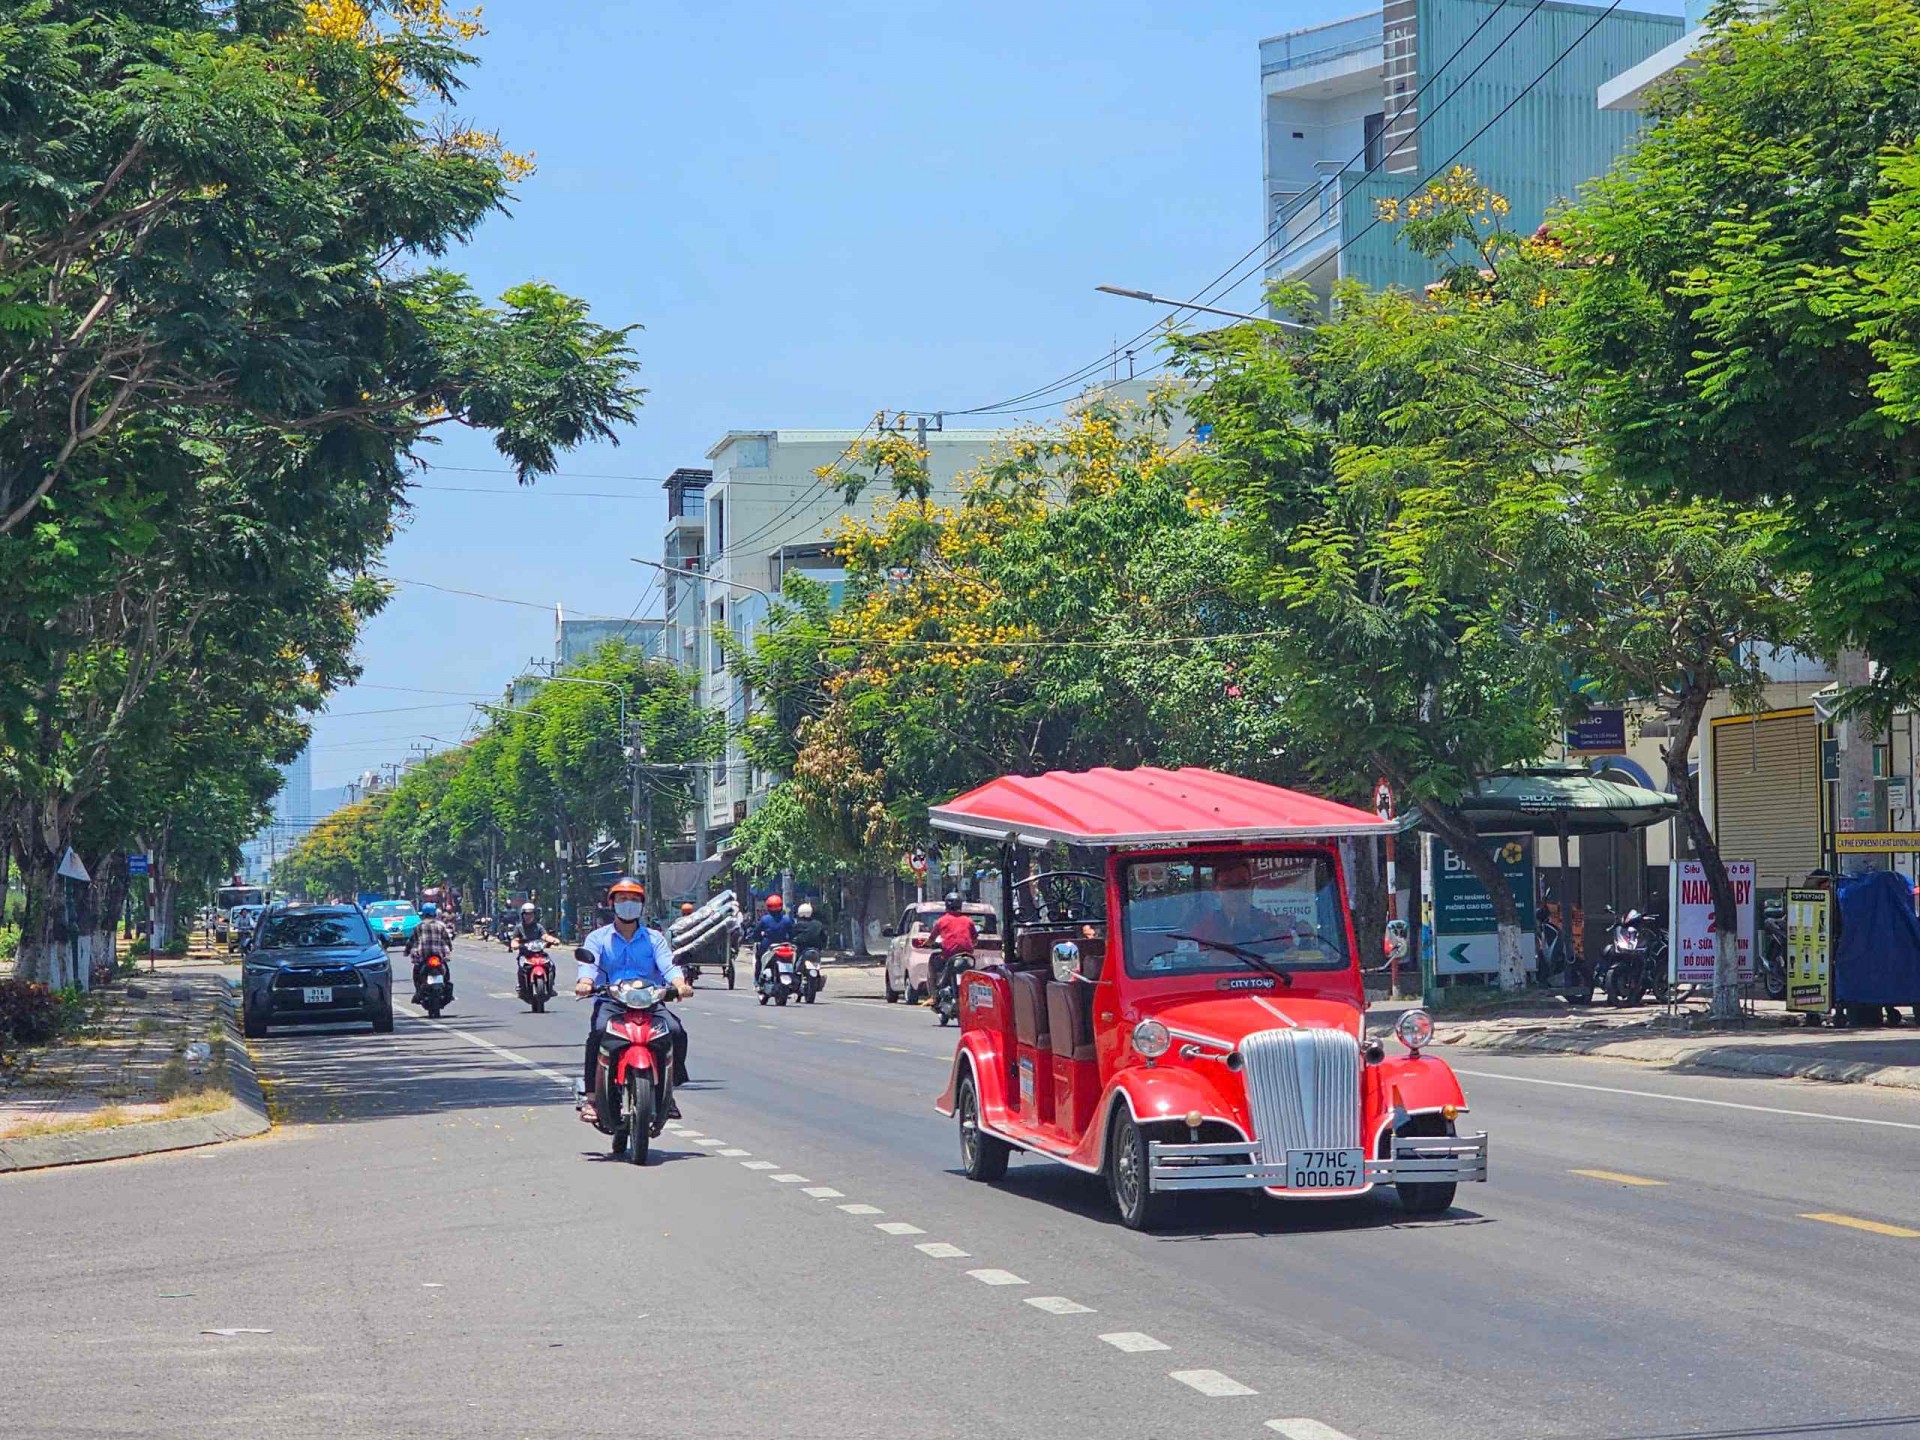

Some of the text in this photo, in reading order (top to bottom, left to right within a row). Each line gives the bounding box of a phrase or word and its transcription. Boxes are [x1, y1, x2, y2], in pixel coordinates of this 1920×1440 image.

[1230, 979, 1275, 988] CITY TOUR
[1303, 1152, 1347, 1168] 77HC
[1296, 1170, 1356, 1187] 000.67
